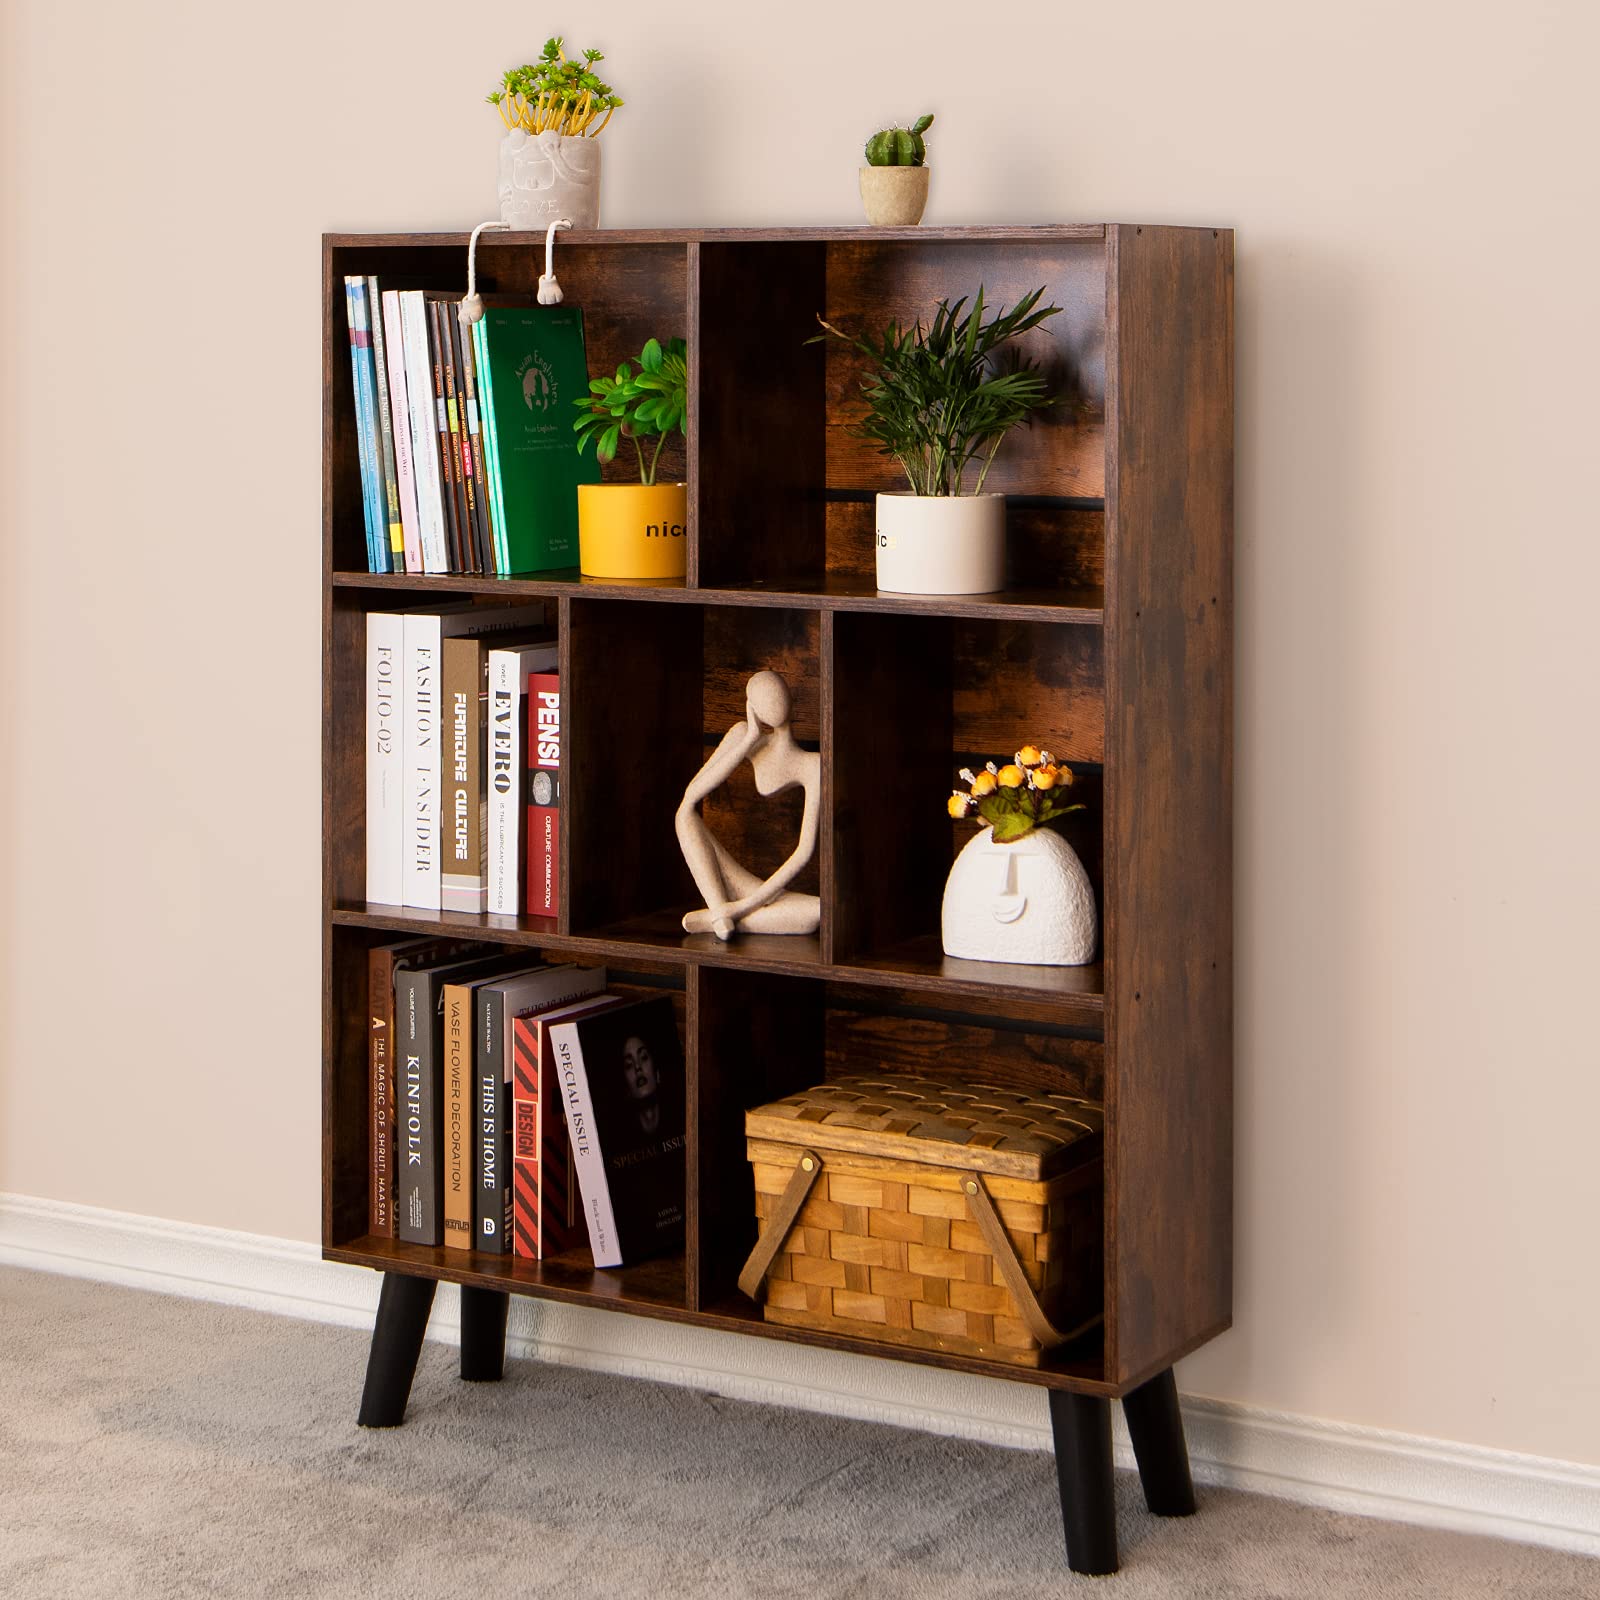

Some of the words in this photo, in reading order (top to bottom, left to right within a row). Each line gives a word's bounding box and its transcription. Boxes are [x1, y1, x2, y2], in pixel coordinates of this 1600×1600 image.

[512, 199, 560, 216] LOVE
[379, 360, 387, 392] GLOBAL
[534, 350, 559, 405] Englishes
[382, 397, 390, 433] ENGLISH
[454, 455, 462, 482] AUSTRALIA
[377, 646, 392, 754] FOLIO-02
[416, 646, 431, 748] FASHION
[453, 693, 467, 782] FURNITURE
[495, 691, 512, 794] EVERO
[537, 691, 561, 766] PENSI
[455, 789, 468, 861] CULTURE
[498, 866, 504, 875] OF
[451, 1001, 461, 1036] VASE
[378, 1063, 386, 1105] MAGIC
[451, 1040, 461, 1098] FLOWER
[483, 1075, 495, 1113] THIS
[378, 1110, 386, 1128] OF
[407, 1055, 422, 1166] KINFOLK
[483, 1117, 495, 1133] IS
[558, 1043, 575, 1110] SPECIAL
[572, 1110, 590, 1157] ISSUE
[378, 1132, 386, 1173] SHRUTI
[451, 1102, 461, 1192] DECORATION
[517, 1103, 534, 1156] DESIGN
[483, 1137, 496, 1189] HOME
[378, 1177, 386, 1226] HAASAN
